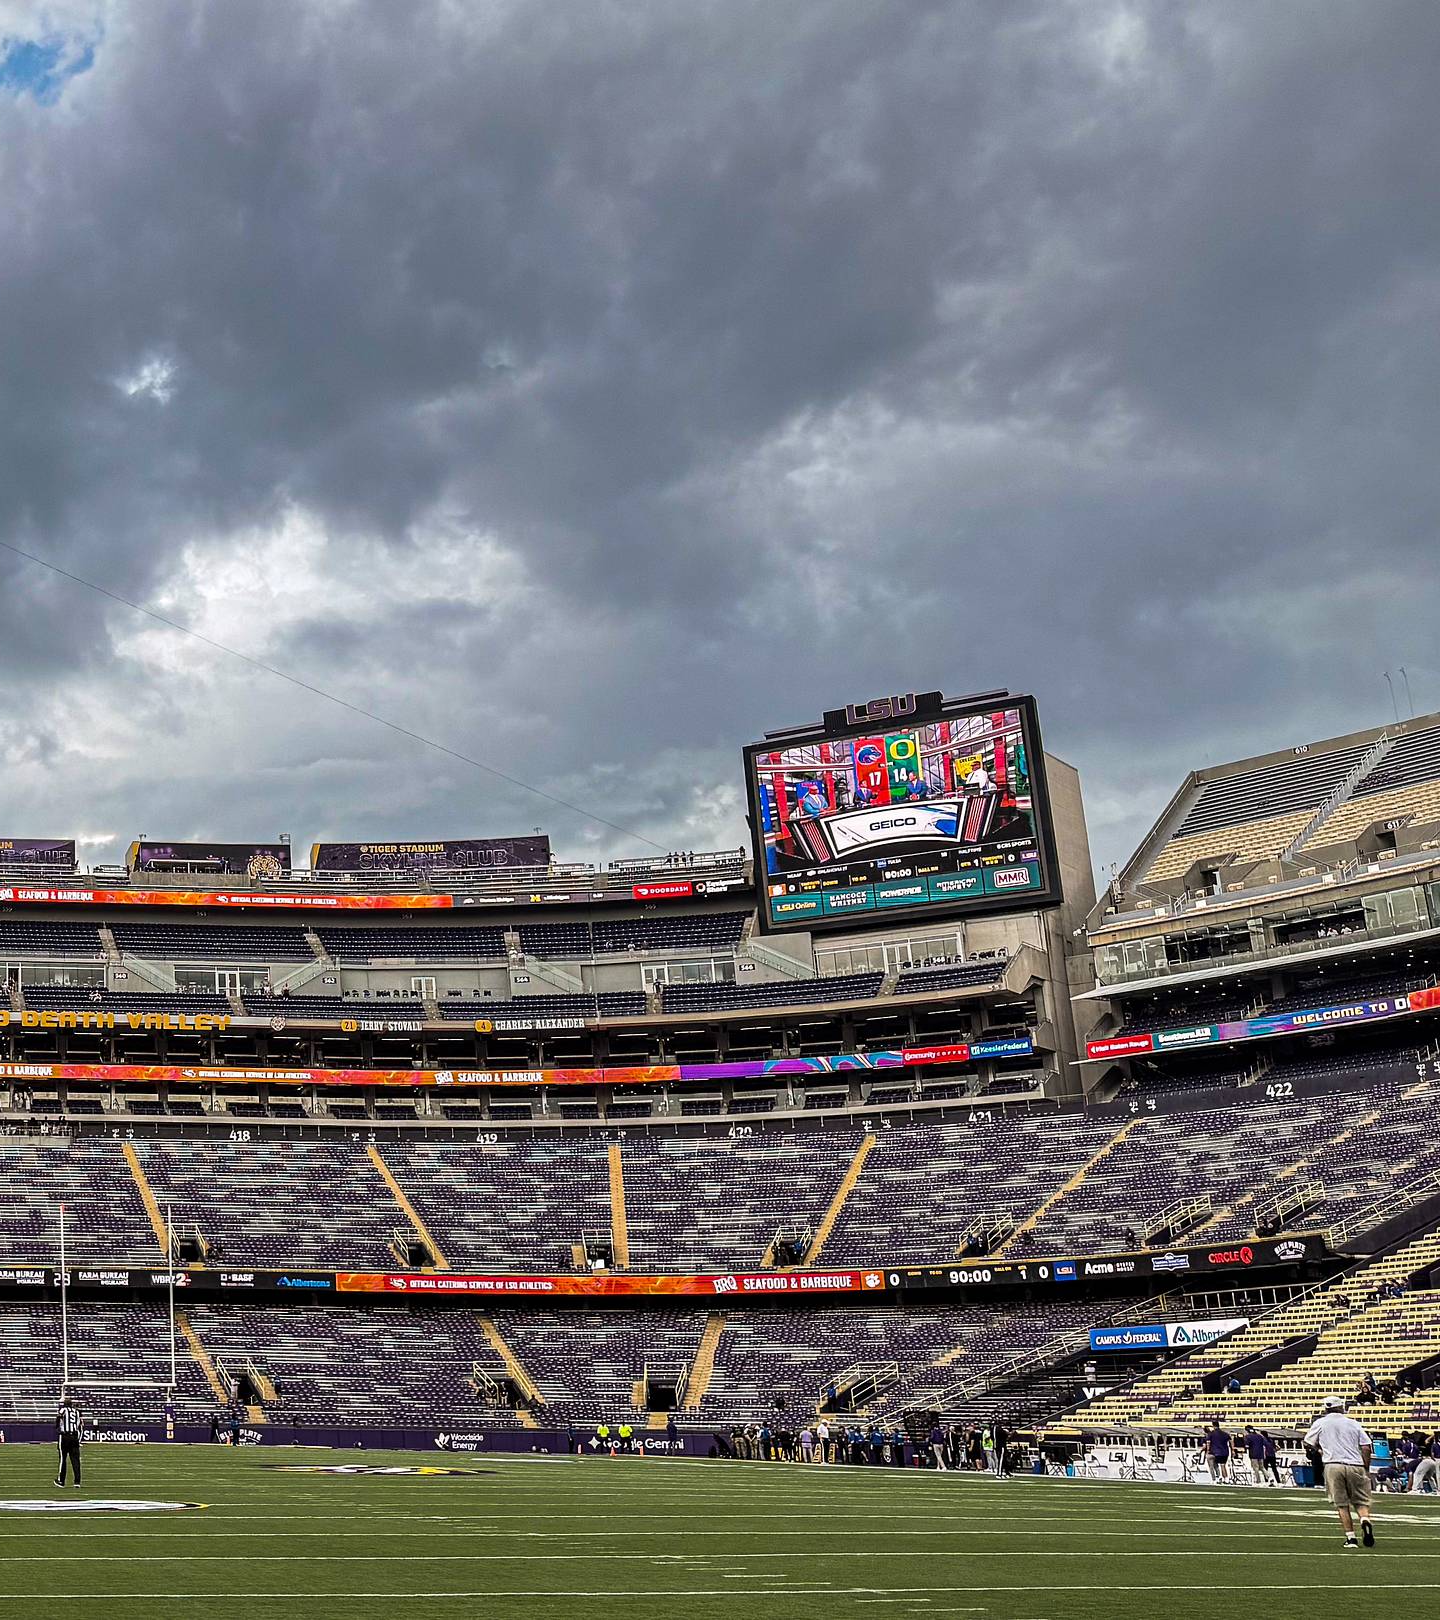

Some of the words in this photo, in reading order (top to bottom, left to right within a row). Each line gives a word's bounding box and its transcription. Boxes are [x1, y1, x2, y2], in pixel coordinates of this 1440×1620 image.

[846, 692, 916, 726] LSU
[1295, 746, 1308, 754] 610
[869, 771, 881, 786] 17
[893, 767, 908, 783] 14
[869, 816, 917, 832] GEICO
[1387, 821, 1400, 830] 611
[369, 844, 397, 853] TIGER
[399, 844, 444, 853] STADIUM
[1011, 840, 1031, 848] SPORTS
[452, 849, 508, 867] CLUB
[885, 868, 911, 879] 90:00
[997, 871, 1026, 885] MMR
[18, 891, 48, 900] SEAFOOD
[50, 892, 56, 900] &
[57, 891, 94, 901] BARBEQUE
[650, 886, 688, 894] DOORDASH
[880, 886, 922, 899] POWERADE
[776, 903, 793, 913] LSU
[795, 901, 816, 911] Online
[830, 897, 867, 908] WHITNEY
[1291, 1006, 1365, 1026] WELCOME
[1368, 1002, 1388, 1013] TO
[21, 1010, 114, 1029] DEATH
[126, 1013, 231, 1031] VALLEY
[344, 1022, 354, 1030] 21
[360, 1021, 384, 1031] JERRY
[388, 1021, 423, 1031] STOVALL
[481, 1021, 486, 1030] 4
[495, 1019, 533, 1030] CHARLES
[535, 1018, 585, 1029] ALEXANDER
[904, 1051, 936, 1061] Community
[936, 1049, 967, 1057] COFFEE
[6, 1065, 12, 1075] &
[13, 1065, 53, 1076] BARBEQUE
[457, 1073, 493, 1083] SEAFOOD
[494, 1073, 500, 1082] &
[502, 1071, 544, 1082] BARBEQUE
[1265, 1082, 1294, 1098] 422
[968, 1111, 992, 1122] 421
[229, 1131, 251, 1142] 418
[476, 1133, 498, 1144] 419
[1274, 1242, 1288, 1254] BLUE
[1288, 1241, 1306, 1252] PLATE
[1208, 1251, 1240, 1264] CIRCLE
[1240, 1246, 1253, 1264] K
[1020, 1269, 1026, 1280] 1
[1038, 1266, 1049, 1279] 0
[1056, 1266, 1073, 1275] LSU
[1085, 1262, 1114, 1275] Acme
[15, 1271, 45, 1279] BUREAU
[78, 1272, 99, 1280] FARM
[99, 1272, 129, 1280] BUREAU
[175, 1273, 187, 1286] 2
[231, 1273, 254, 1281] BASF
[890, 1273, 900, 1286] 0
[949, 1269, 991, 1284] 90:00
[291, 1277, 331, 1288] Albertsons
[410, 1280, 436, 1288] OFFICIAL
[437, 1280, 467, 1289] CATERING
[468, 1280, 495, 1289] SERVICE
[495, 1280, 504, 1289] OF
[505, 1280, 518, 1289] LSU
[518, 1281, 553, 1290] ATHLETICS
[713, 1275, 738, 1294] BRQ
[743, 1277, 787, 1290] SEAFOOD
[790, 1277, 798, 1289] &
[800, 1275, 852, 1289] BARBEQUE
[1095, 1335, 1122, 1345] CAMPUS
[1132, 1333, 1162, 1344] FEDERAL
[69, 1409, 77, 1423] S
[83, 1430, 146, 1442] ShipStation
[219, 1430, 233, 1441] BLU
[239, 1429, 263, 1441] PLATE
[450, 1433, 483, 1442] Woodside
[452, 1441, 477, 1452] Energy
[1109, 1451, 1127, 1462] LSU
